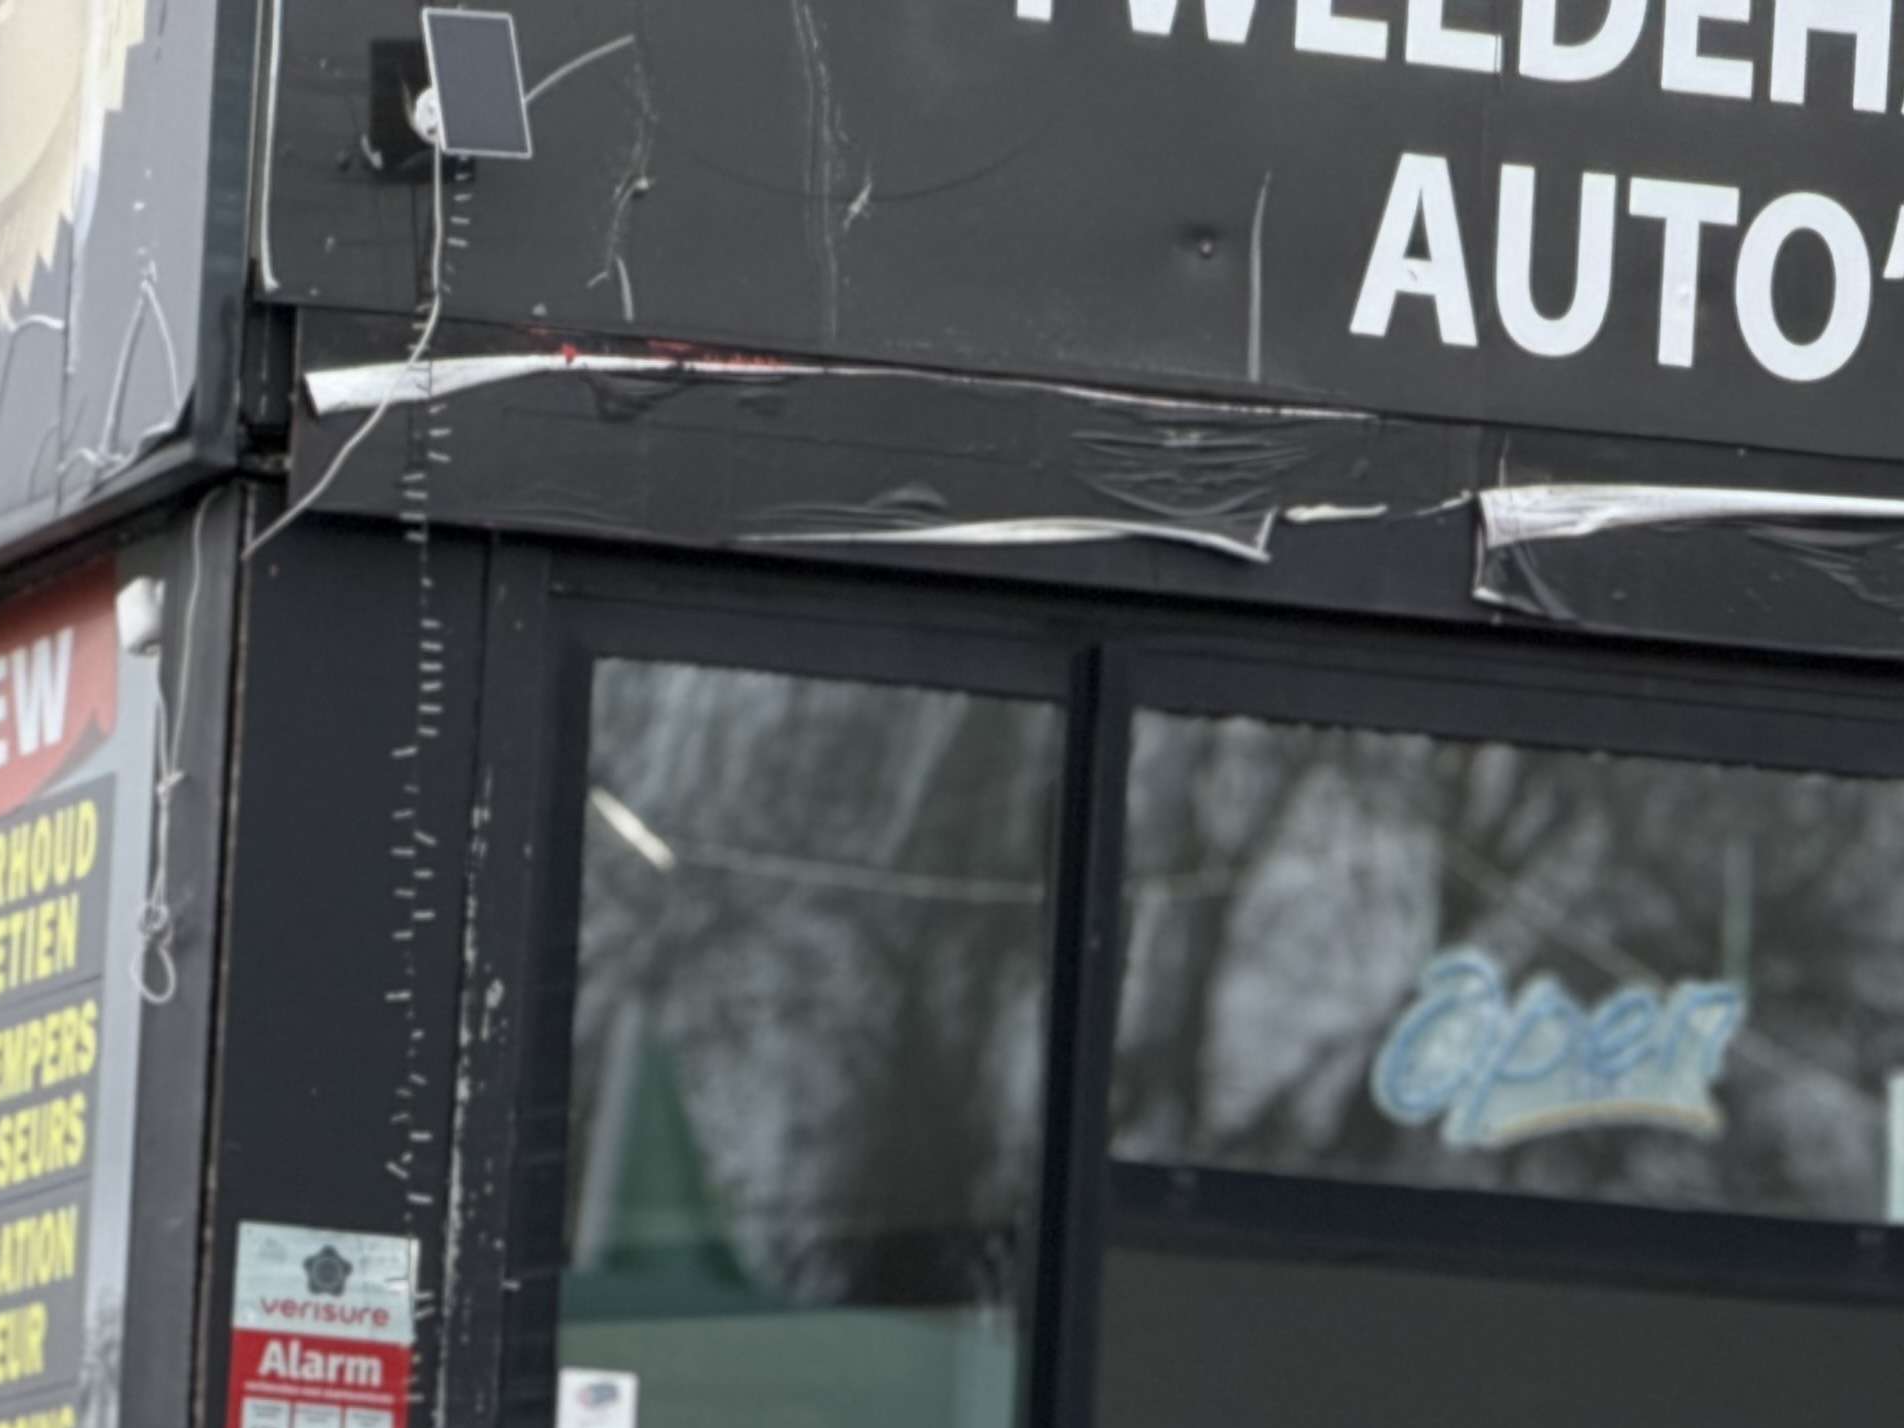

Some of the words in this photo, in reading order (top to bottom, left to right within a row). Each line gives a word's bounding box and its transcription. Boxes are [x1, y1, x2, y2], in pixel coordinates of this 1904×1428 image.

[1372, 948, 1746, 1148] Open
[258, 1296, 390, 1329] verisure
[258, 1339, 384, 1388] Alarm
